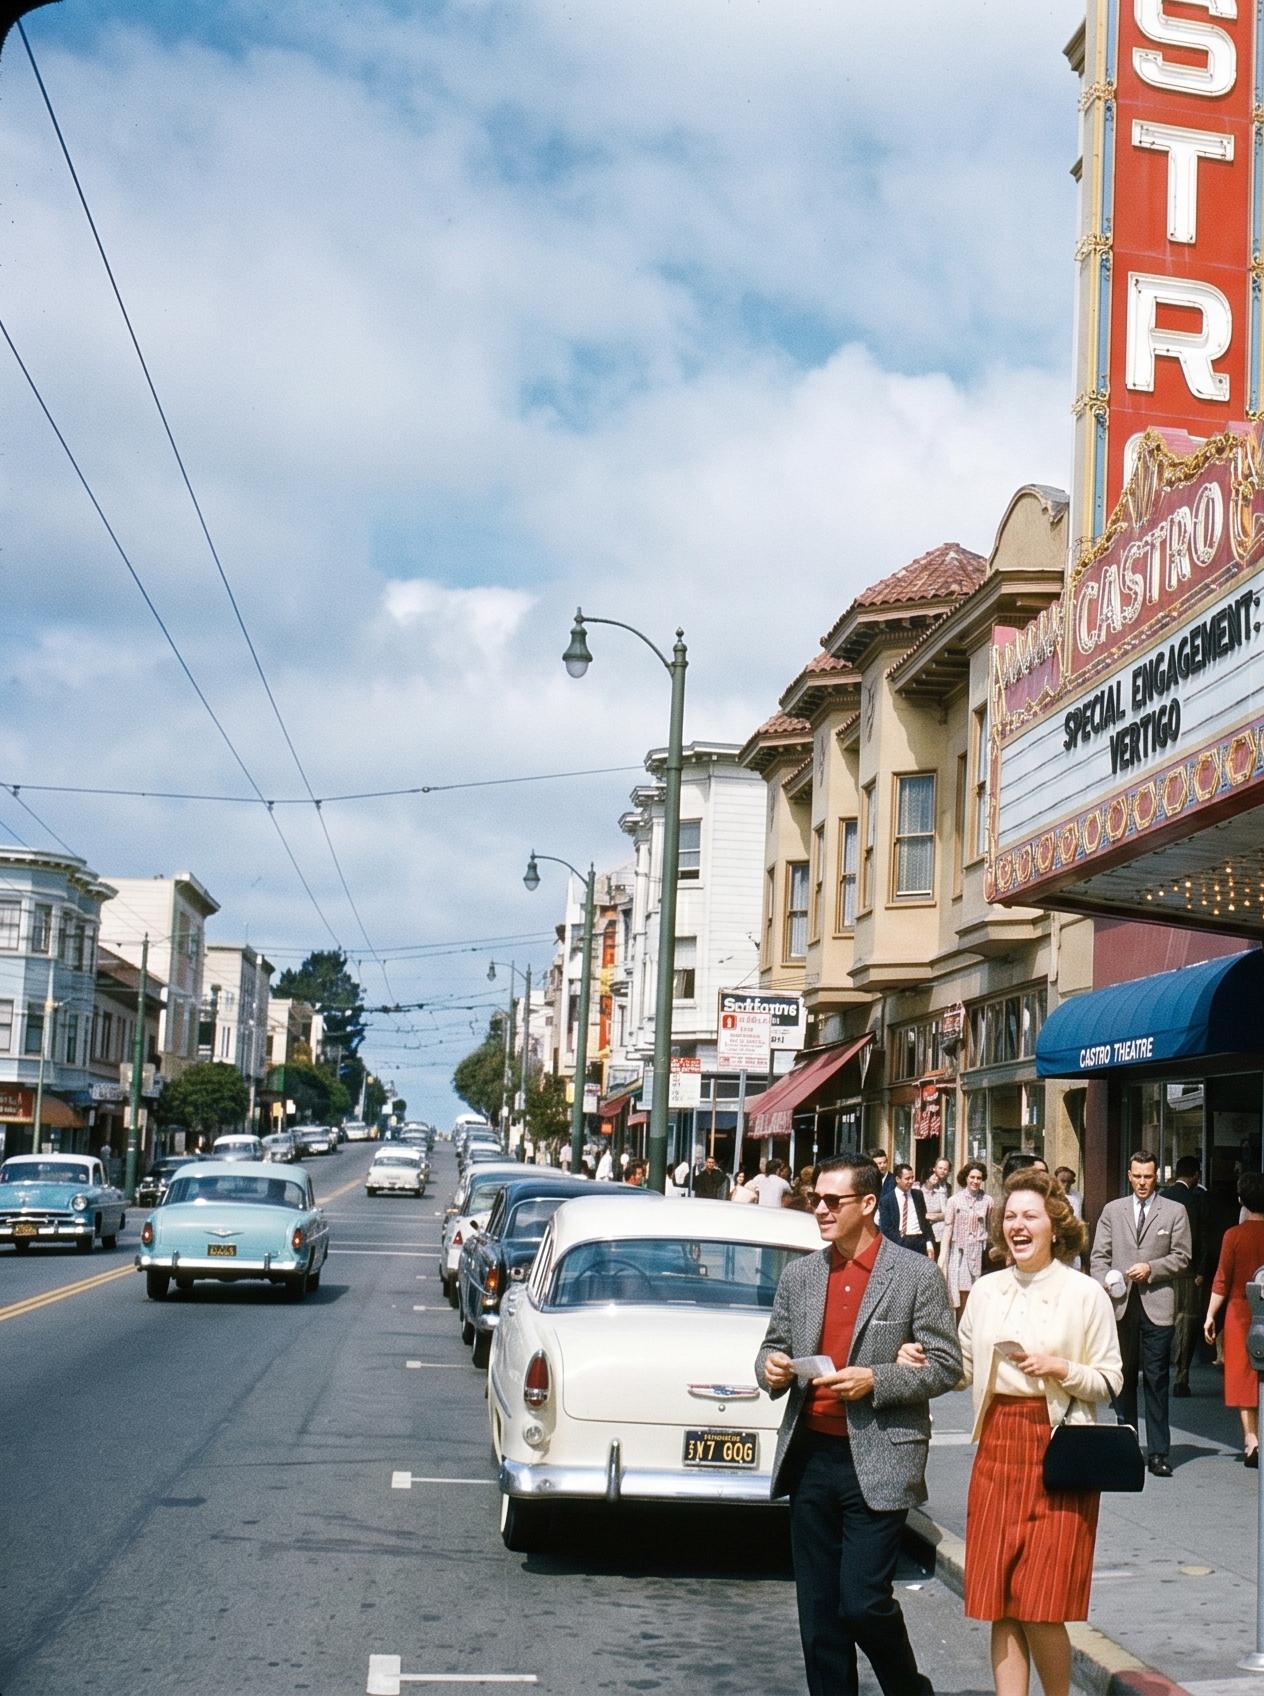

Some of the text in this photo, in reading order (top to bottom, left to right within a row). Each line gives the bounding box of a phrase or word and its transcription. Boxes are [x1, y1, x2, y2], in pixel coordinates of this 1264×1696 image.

[1076, 481, 1224, 655] CASTRO
[1063, 589, 1262, 751] SPECIAL ENGAGEMENT:
[1109, 697, 1182, 775] VERTIGO
[1079, 1036, 1154, 1068] CASTRO THEATRE
